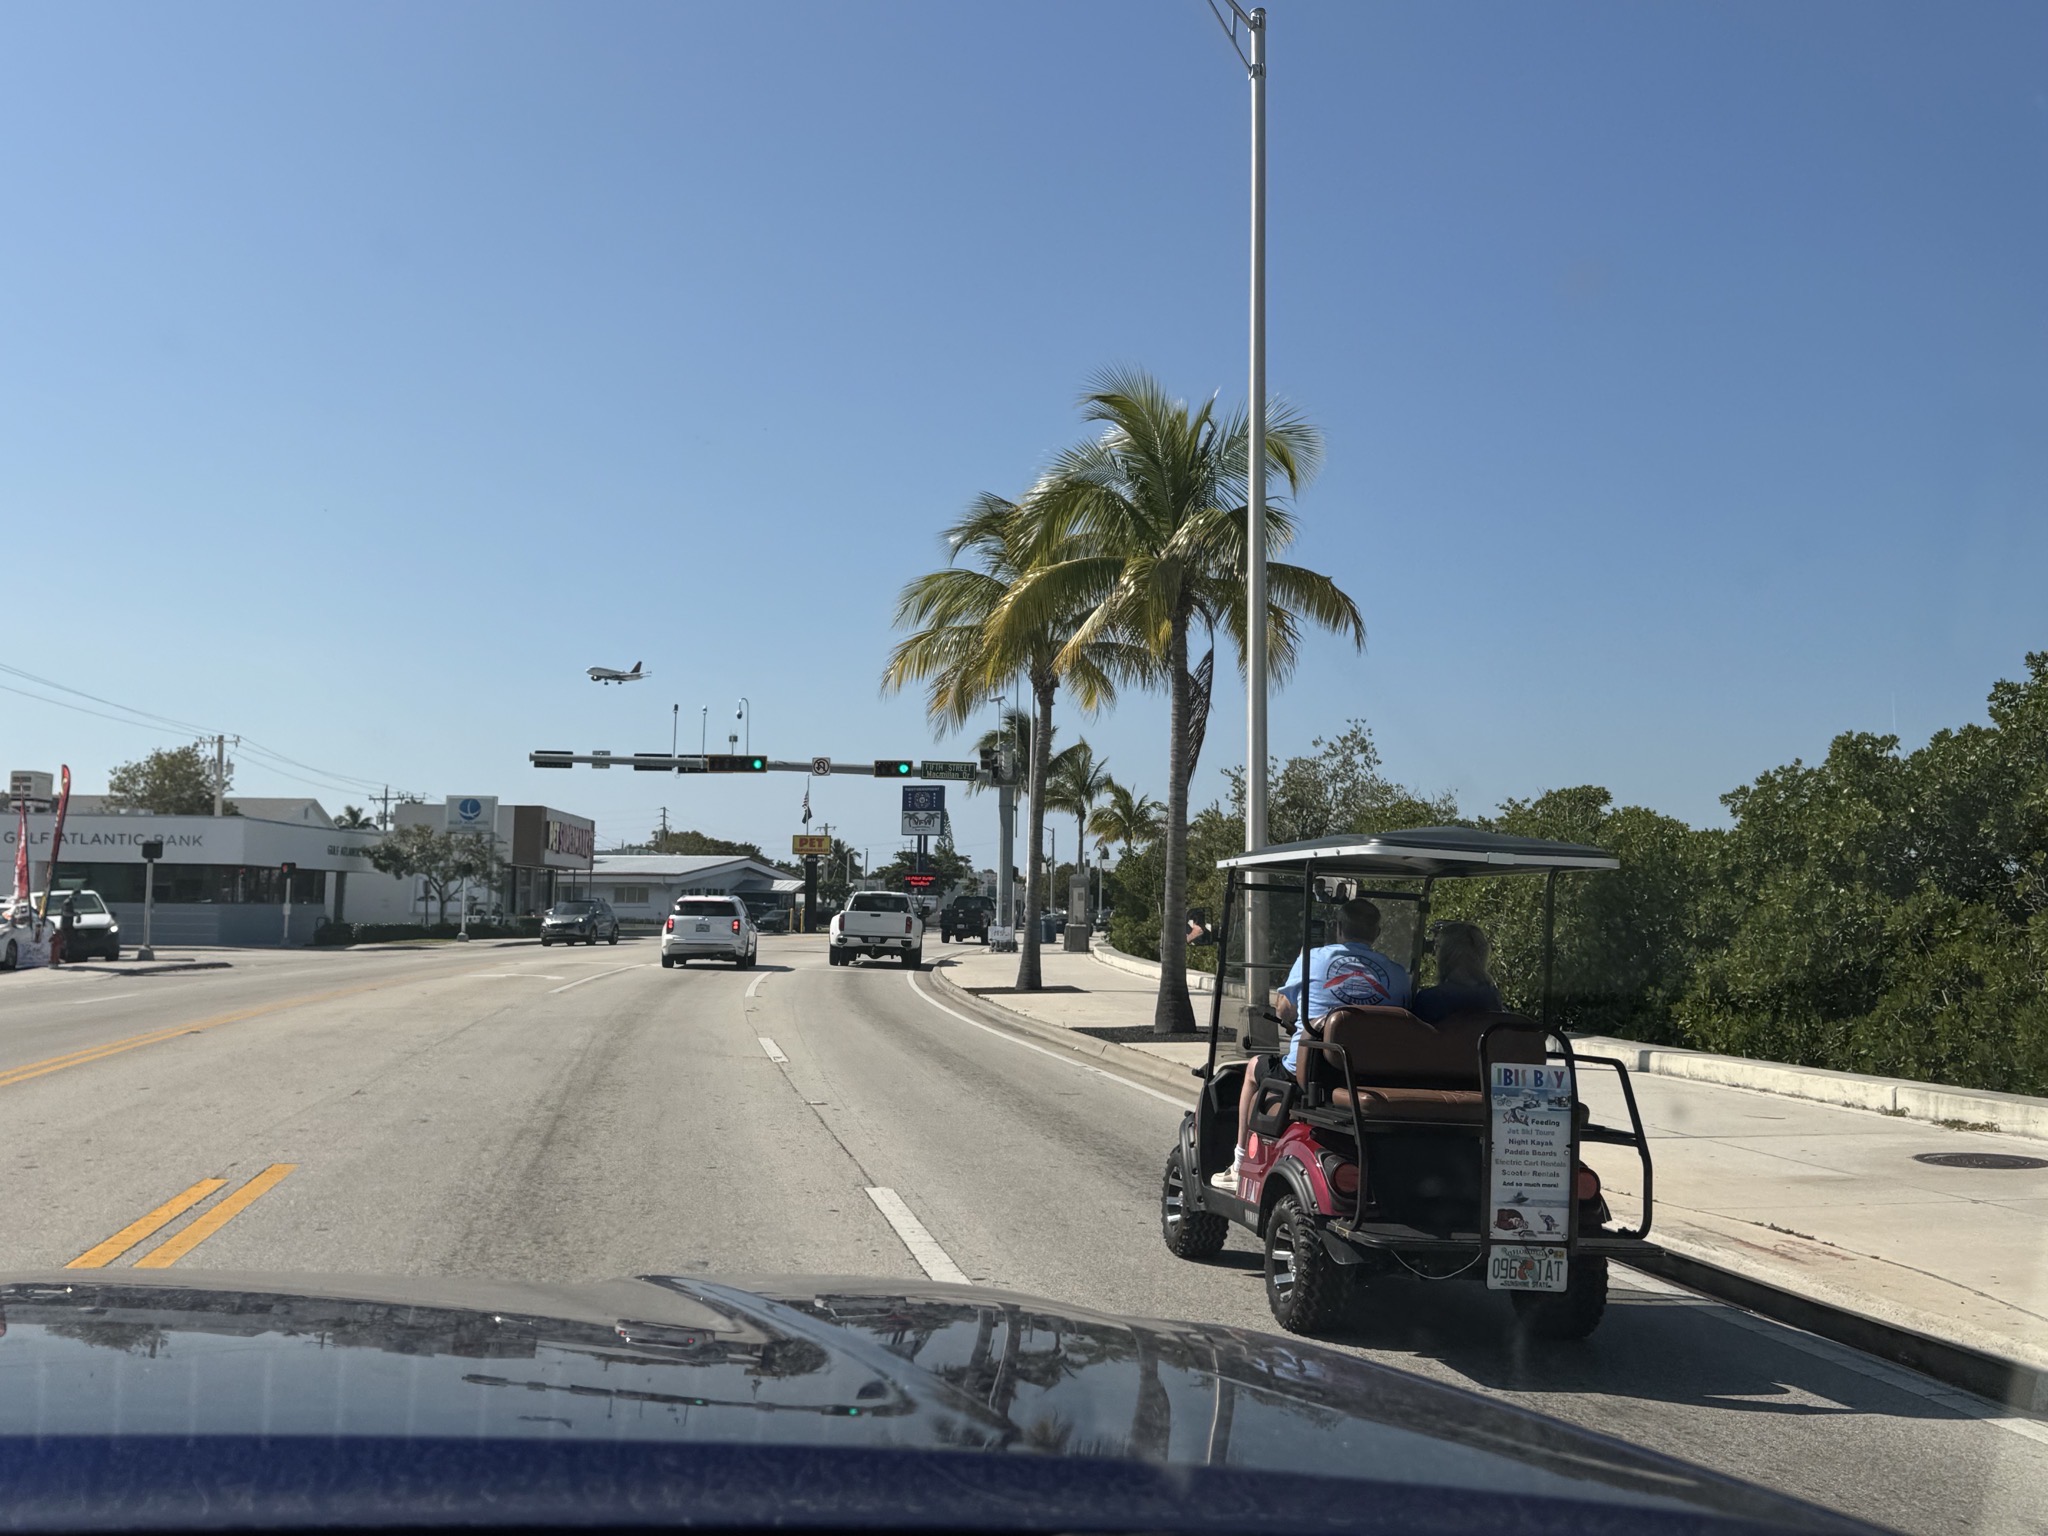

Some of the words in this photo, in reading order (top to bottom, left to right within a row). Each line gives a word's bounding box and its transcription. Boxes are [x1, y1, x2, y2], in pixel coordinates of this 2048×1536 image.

[925, 763, 944, 771] FIFTH
[948, 764, 971, 772] STREET
[962, 771, 971, 779] Dr
[3, 831, 50, 845] GLF
[799, 837, 825, 848] PET
[1497, 1068, 1527, 1087] IBIS
[1534, 1069, 1565, 1089] BAY
[1531, 1119, 1560, 1127] Feeding
[1508, 1138, 1528, 1146] Night
[1530, 1139, 1553, 1147] Kayak
[1504, 1148, 1530, 1156] Paddle
[1532, 1149, 1557, 1157] Boards
[1495, 1158, 1522, 1166] Electric
[1540, 1160, 1566, 1168] Rentals
[1532, 1170, 1560, 1178] Rentals
[1492, 1257, 1518, 1280] 096
